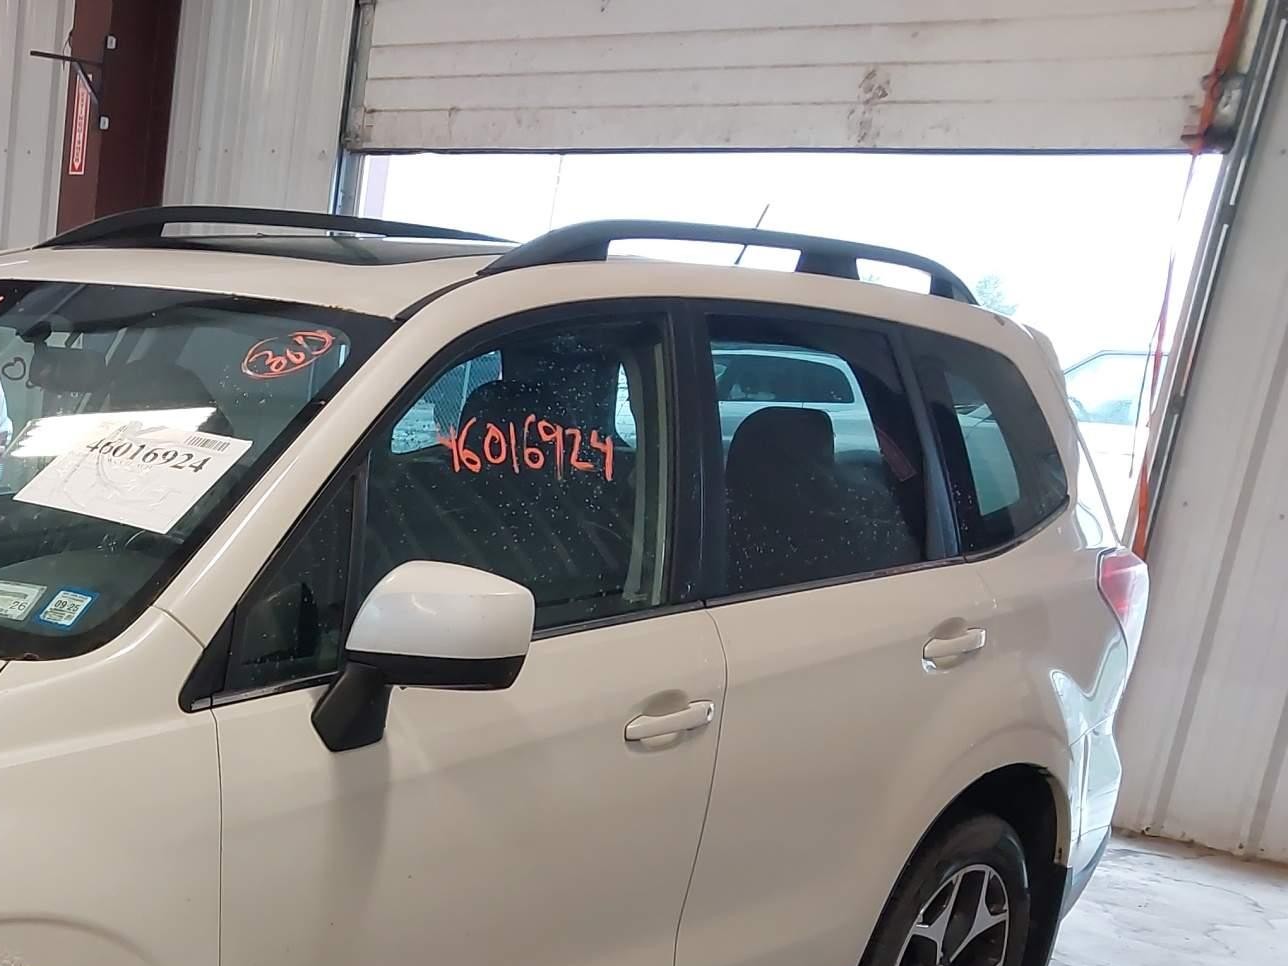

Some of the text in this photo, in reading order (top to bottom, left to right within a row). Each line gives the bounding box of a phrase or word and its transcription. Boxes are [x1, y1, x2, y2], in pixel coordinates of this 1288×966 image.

[86, 438, 212, 473] 46016924
[436, 414, 614, 481] 46016924
[9, 600, 28, 611] 26
